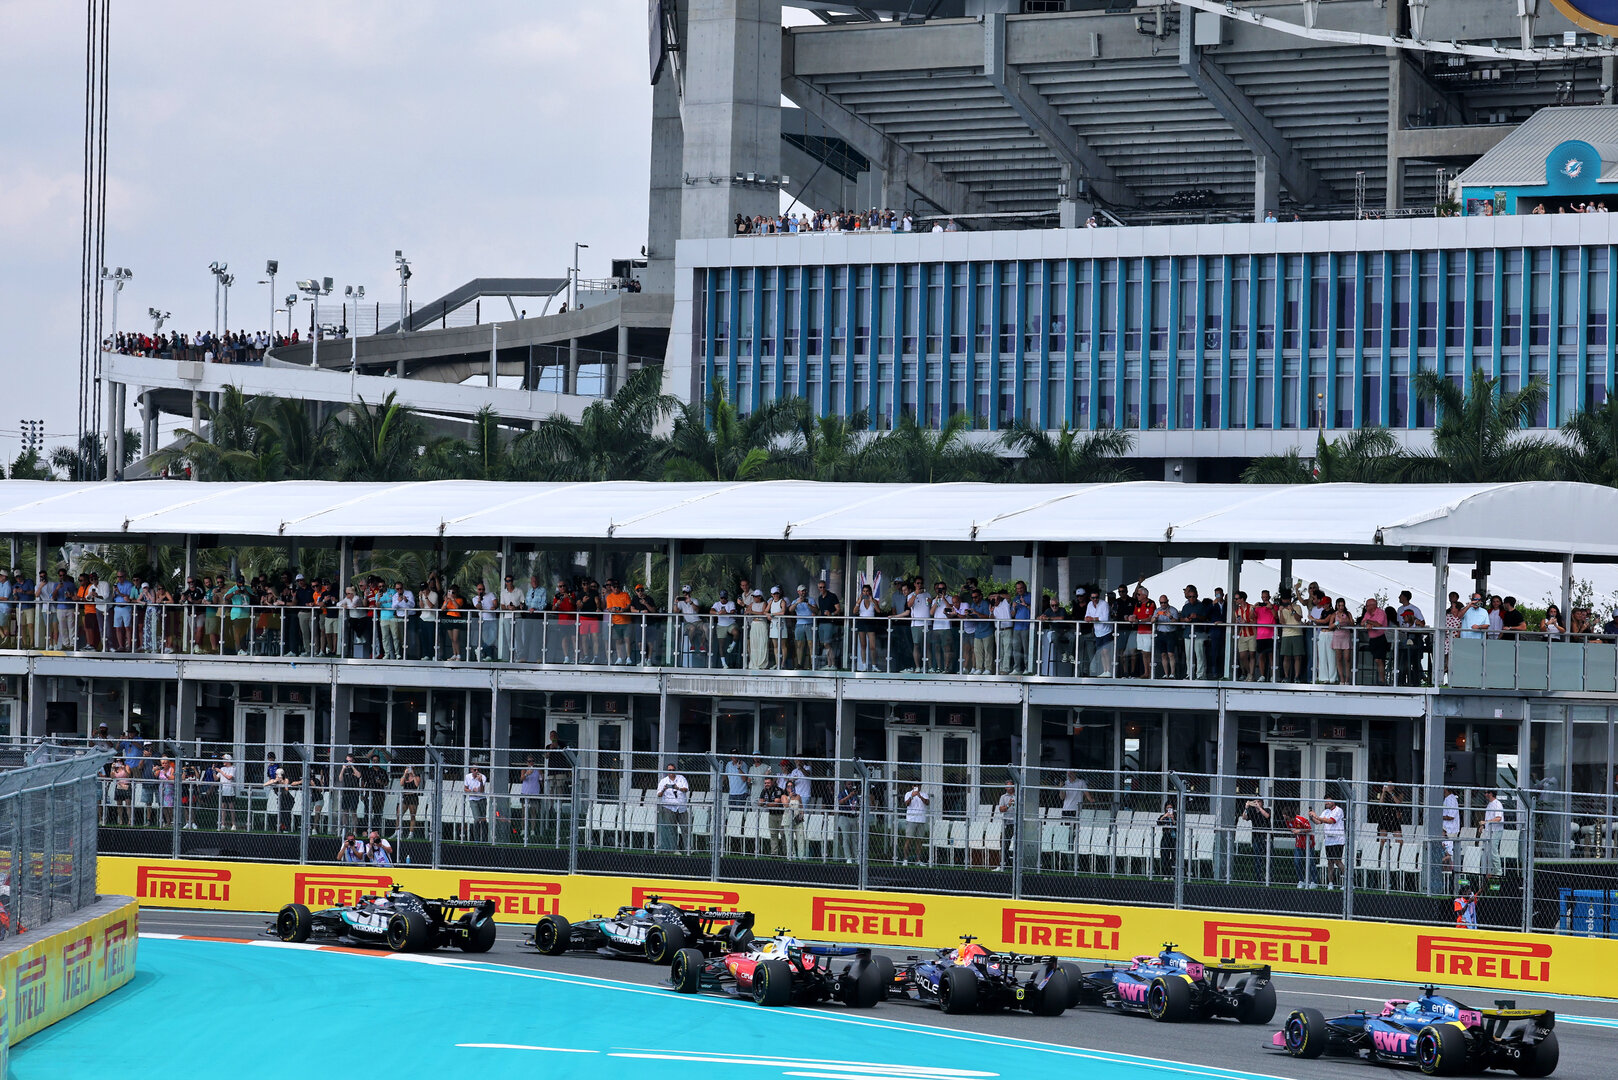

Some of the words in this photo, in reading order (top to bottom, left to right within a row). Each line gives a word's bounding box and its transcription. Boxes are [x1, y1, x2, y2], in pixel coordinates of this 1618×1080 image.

[1334, 727, 1345, 736] EXIT
[136, 866, 231, 901] PIRELLI
[294, 873, 393, 906] PIREL
[459, 879, 561, 915] PRELLI
[351, 923, 384, 934] PETRONAS
[812, 897, 925, 937] PIRELLI
[609, 935, 642, 946] PETRONAS
[1002, 908, 1121, 950] PIRELLI
[1203, 921, 1330, 965] PIRELLI
[804, 954, 815, 963] 44
[988, 955, 1050, 964] ORACLE
[1416, 935, 1552, 981] PIRELLI
[1118, 982, 1148, 1002] BWT
[1431, 1003, 1445, 1013] eni
[1373, 1030, 1411, 1053] BWT
